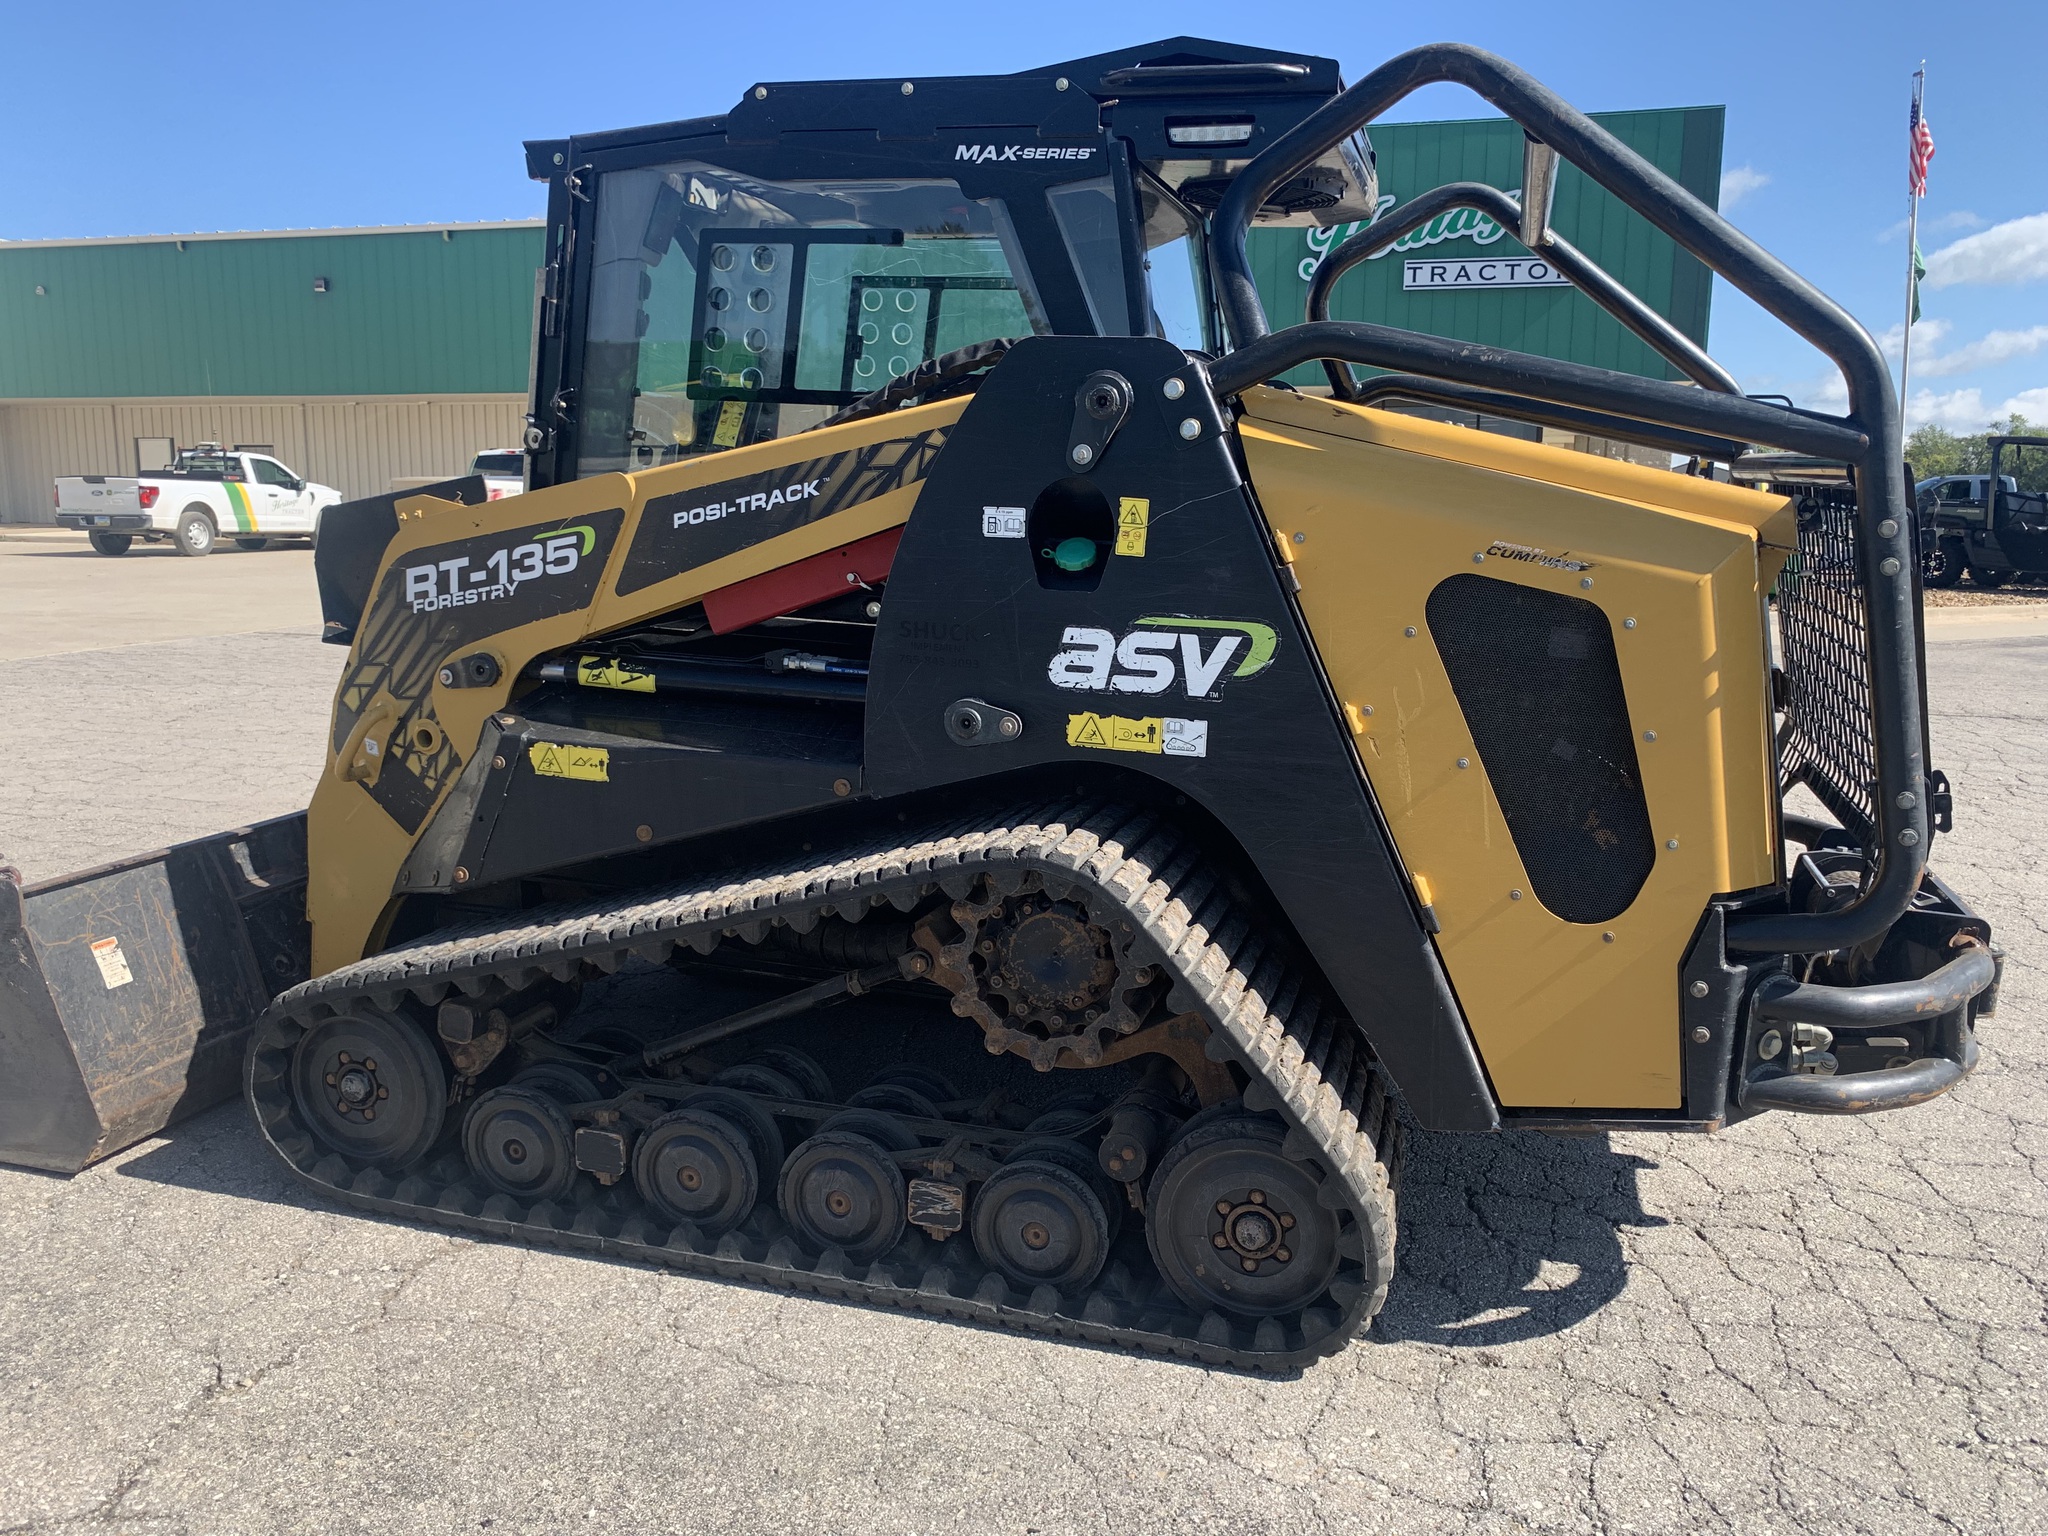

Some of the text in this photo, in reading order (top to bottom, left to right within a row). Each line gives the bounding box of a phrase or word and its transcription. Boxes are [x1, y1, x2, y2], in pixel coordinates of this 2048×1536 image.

[954, 145, 1091, 164] MAX-SERIES
[673, 479, 820, 529] POSI-TRACK
[405, 535, 579, 603] RT-135
[412, 581, 519, 614] FORESTRY
[899, 620, 978, 642] SHUCK
